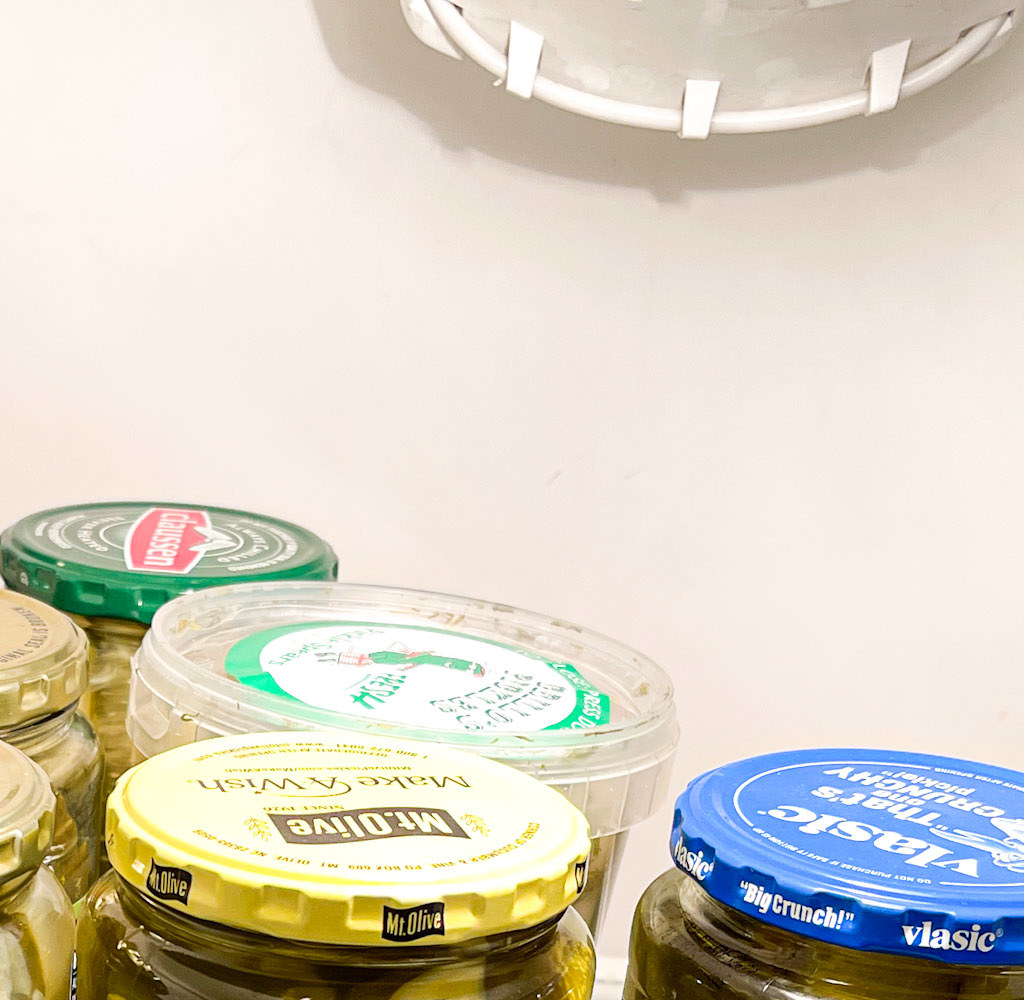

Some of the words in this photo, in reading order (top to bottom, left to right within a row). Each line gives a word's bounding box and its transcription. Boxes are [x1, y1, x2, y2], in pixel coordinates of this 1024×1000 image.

[582, 690, 602, 721] PRESS
[359, 774, 472, 794] Make
[822, 766, 1006, 818] CRUNCHY
[871, 790, 926, 808] one
[768, 805, 980, 879] vlasic
[841, 863, 893, 878] PURCHASE
[894, 874, 915, 882] NOT
[916, 876, 932, 884] DO
[386, 910, 444, 937] Mt.Olive
[902, 921, 995, 952] vlasic
